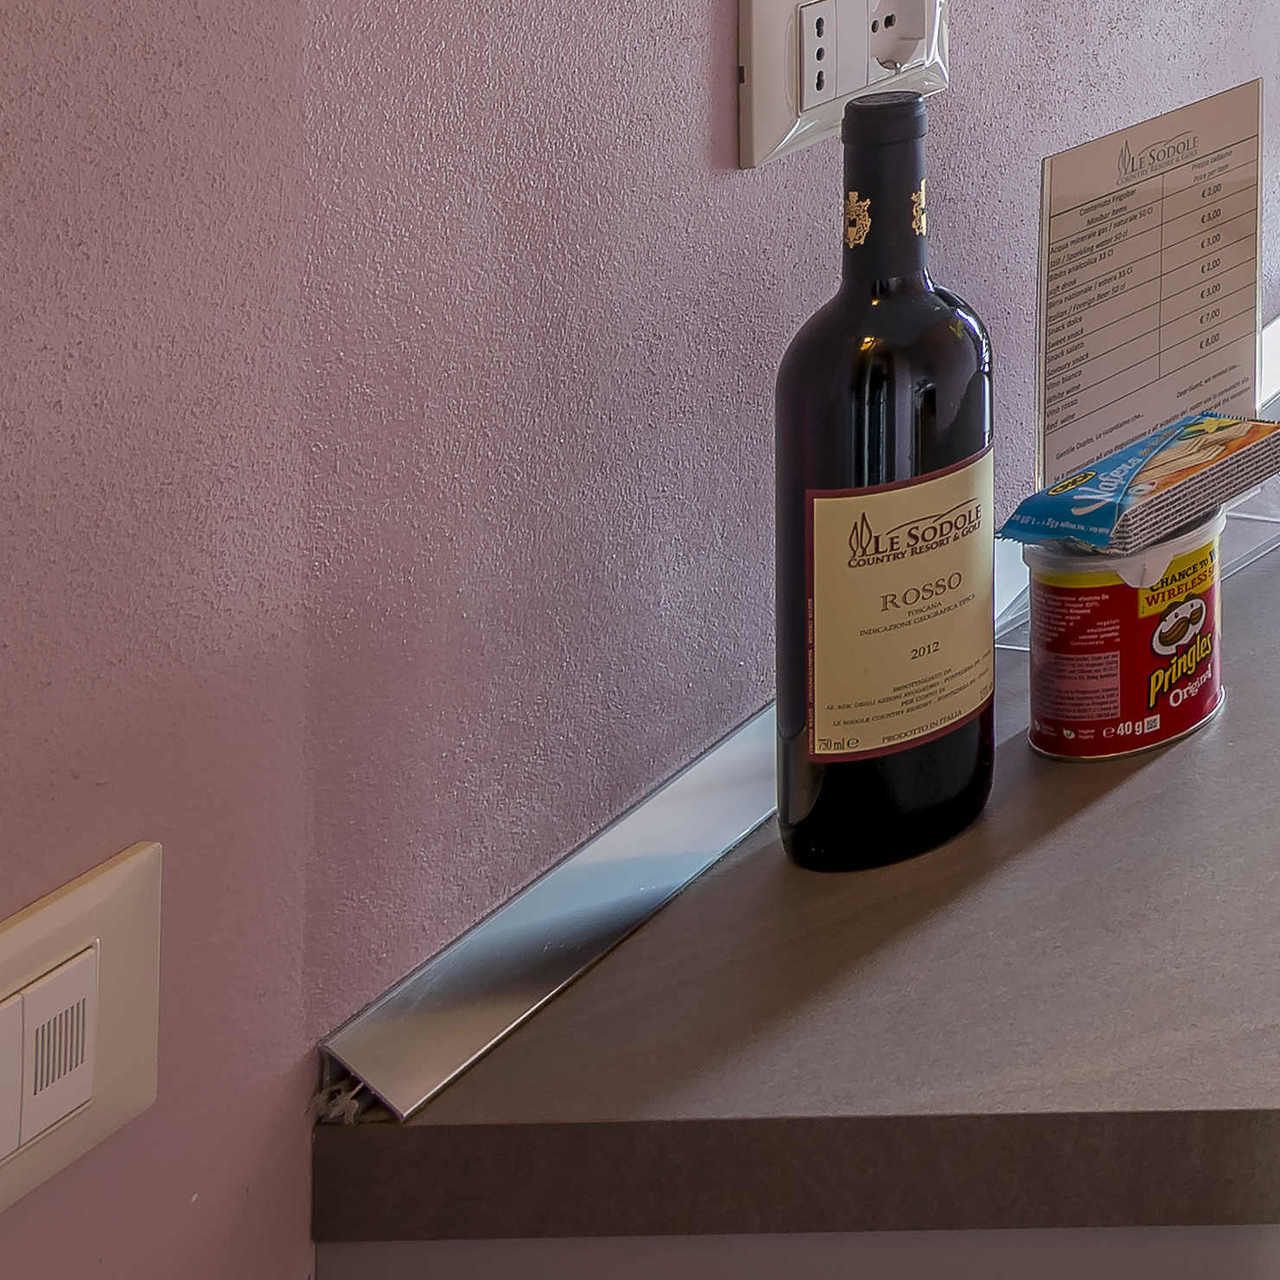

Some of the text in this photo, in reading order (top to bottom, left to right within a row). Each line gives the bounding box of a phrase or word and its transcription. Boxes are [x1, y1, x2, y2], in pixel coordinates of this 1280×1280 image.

[1131, 135, 1199, 173] LE SODOLE
[1111, 188, 1136, 203] Frigobar
[848, 520, 981, 568] COUNTRY RESORT & GOLF
[873, 534, 900, 555] LE
[906, 503, 982, 549] SODOLE
[880, 571, 962, 612] ROSSO
[1144, 570, 1208, 607] WIRELESS
[859, 619, 912, 636] INDICAZIONE
[913, 603, 958, 625] GEOGRAFICA
[907, 601, 943, 617] TOSCANA
[911, 641, 940, 660] 2012
[1149, 632, 1212, 709] Pringles
[1169, 663, 1212, 707] Original
[817, 737, 845, 751] 750 ml
[882, 724, 929, 744] PRODOTTO
[1117, 720, 1143, 736] 40 g
